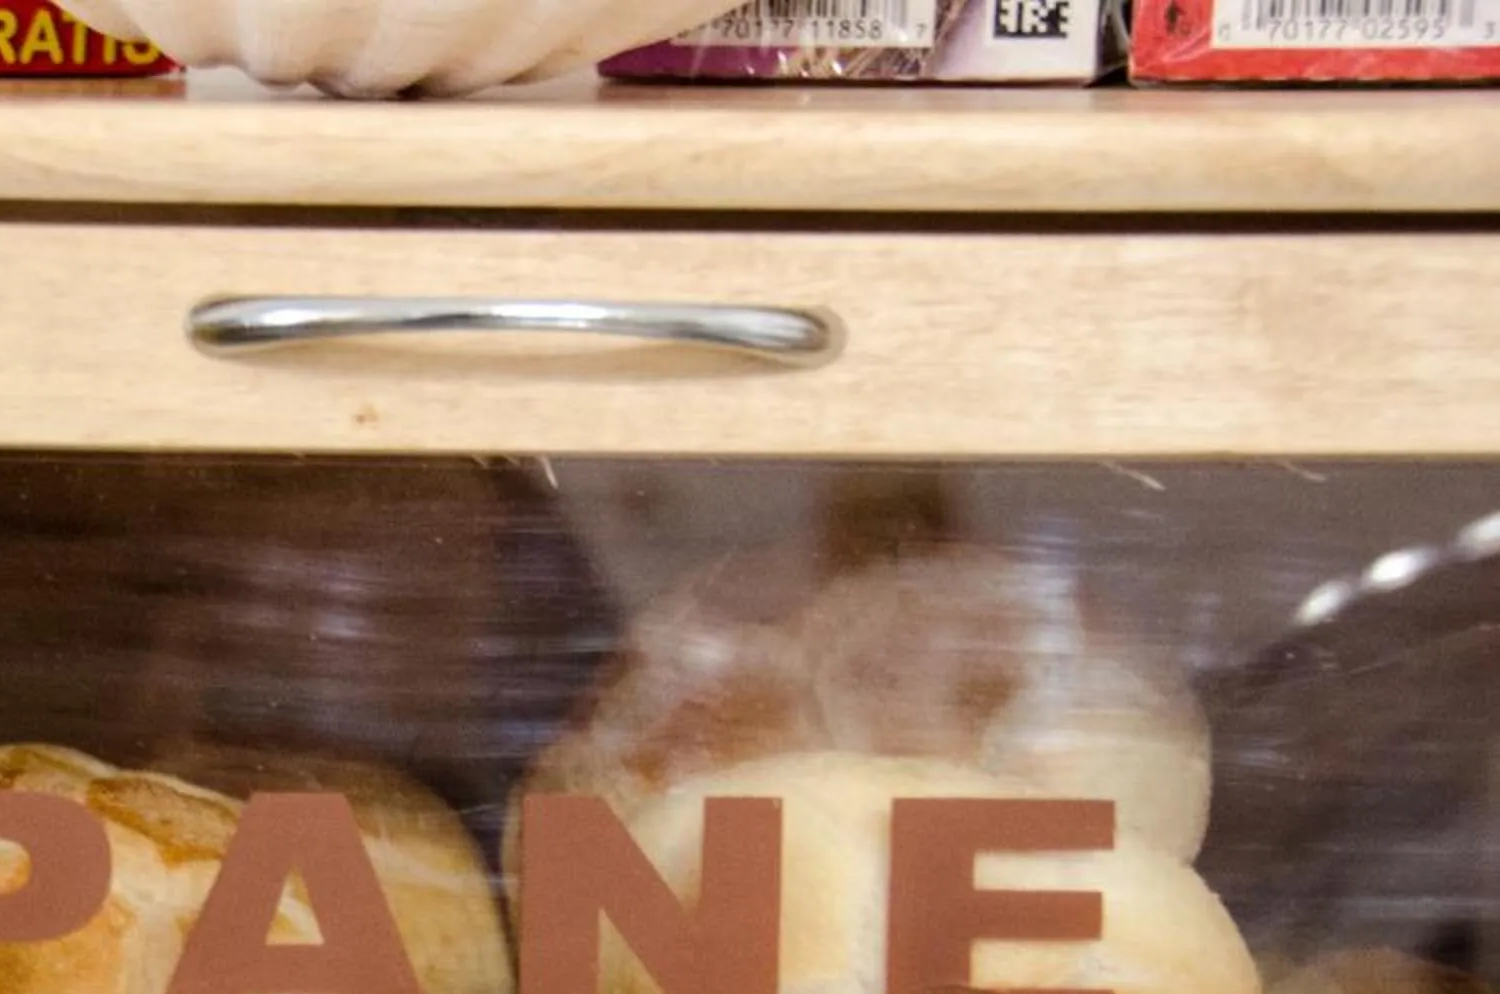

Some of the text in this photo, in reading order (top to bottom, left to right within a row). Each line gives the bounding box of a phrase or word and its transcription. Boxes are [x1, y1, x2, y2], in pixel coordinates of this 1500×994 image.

[811, 20, 883, 39] 11858
[1268, 20, 1348, 41] 70177
[1362, 19, 1445, 40] 02595
